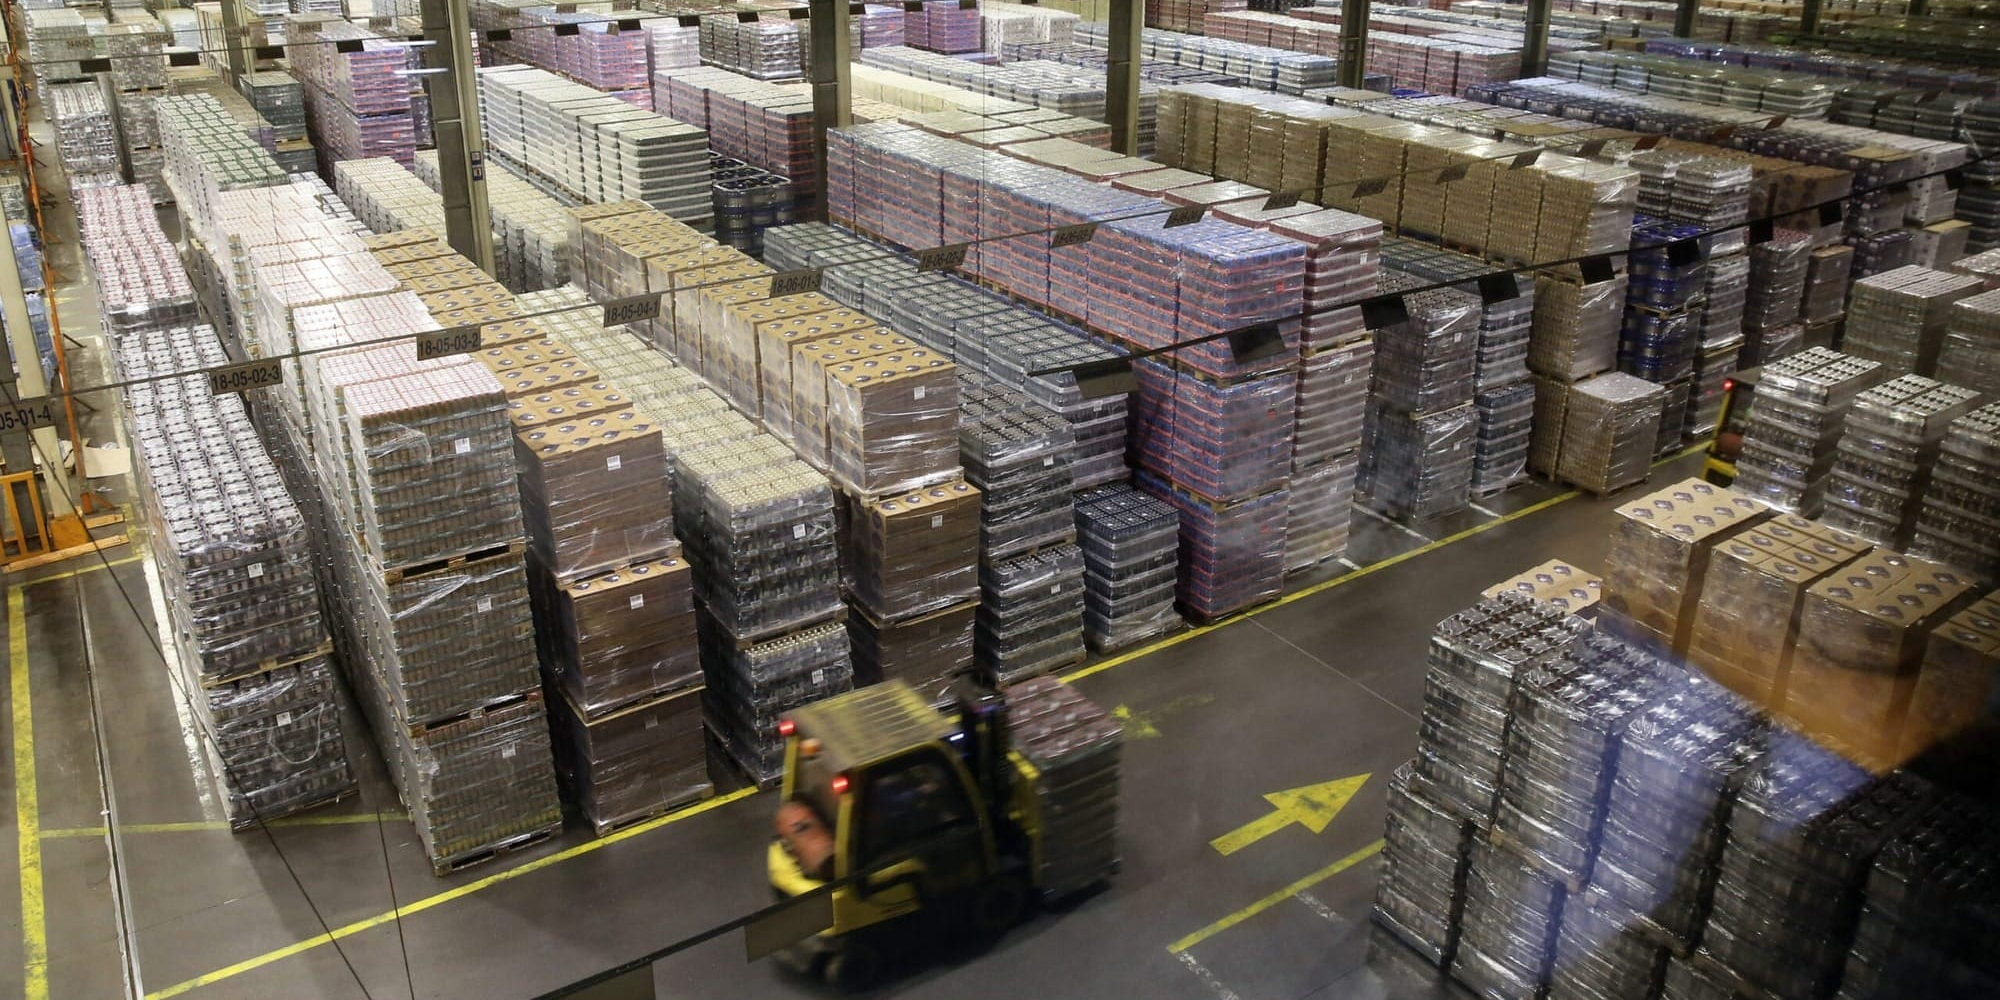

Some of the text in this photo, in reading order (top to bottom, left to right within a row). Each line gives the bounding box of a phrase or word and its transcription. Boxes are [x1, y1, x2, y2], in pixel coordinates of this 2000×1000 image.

[772, 273, 821, 293] 18-06-01-3
[606, 299, 658, 322] 18-05-04-1
[418, 332, 479, 356] 18-05-03-2
[211, 364, 280, 390] 18-05-02-3
